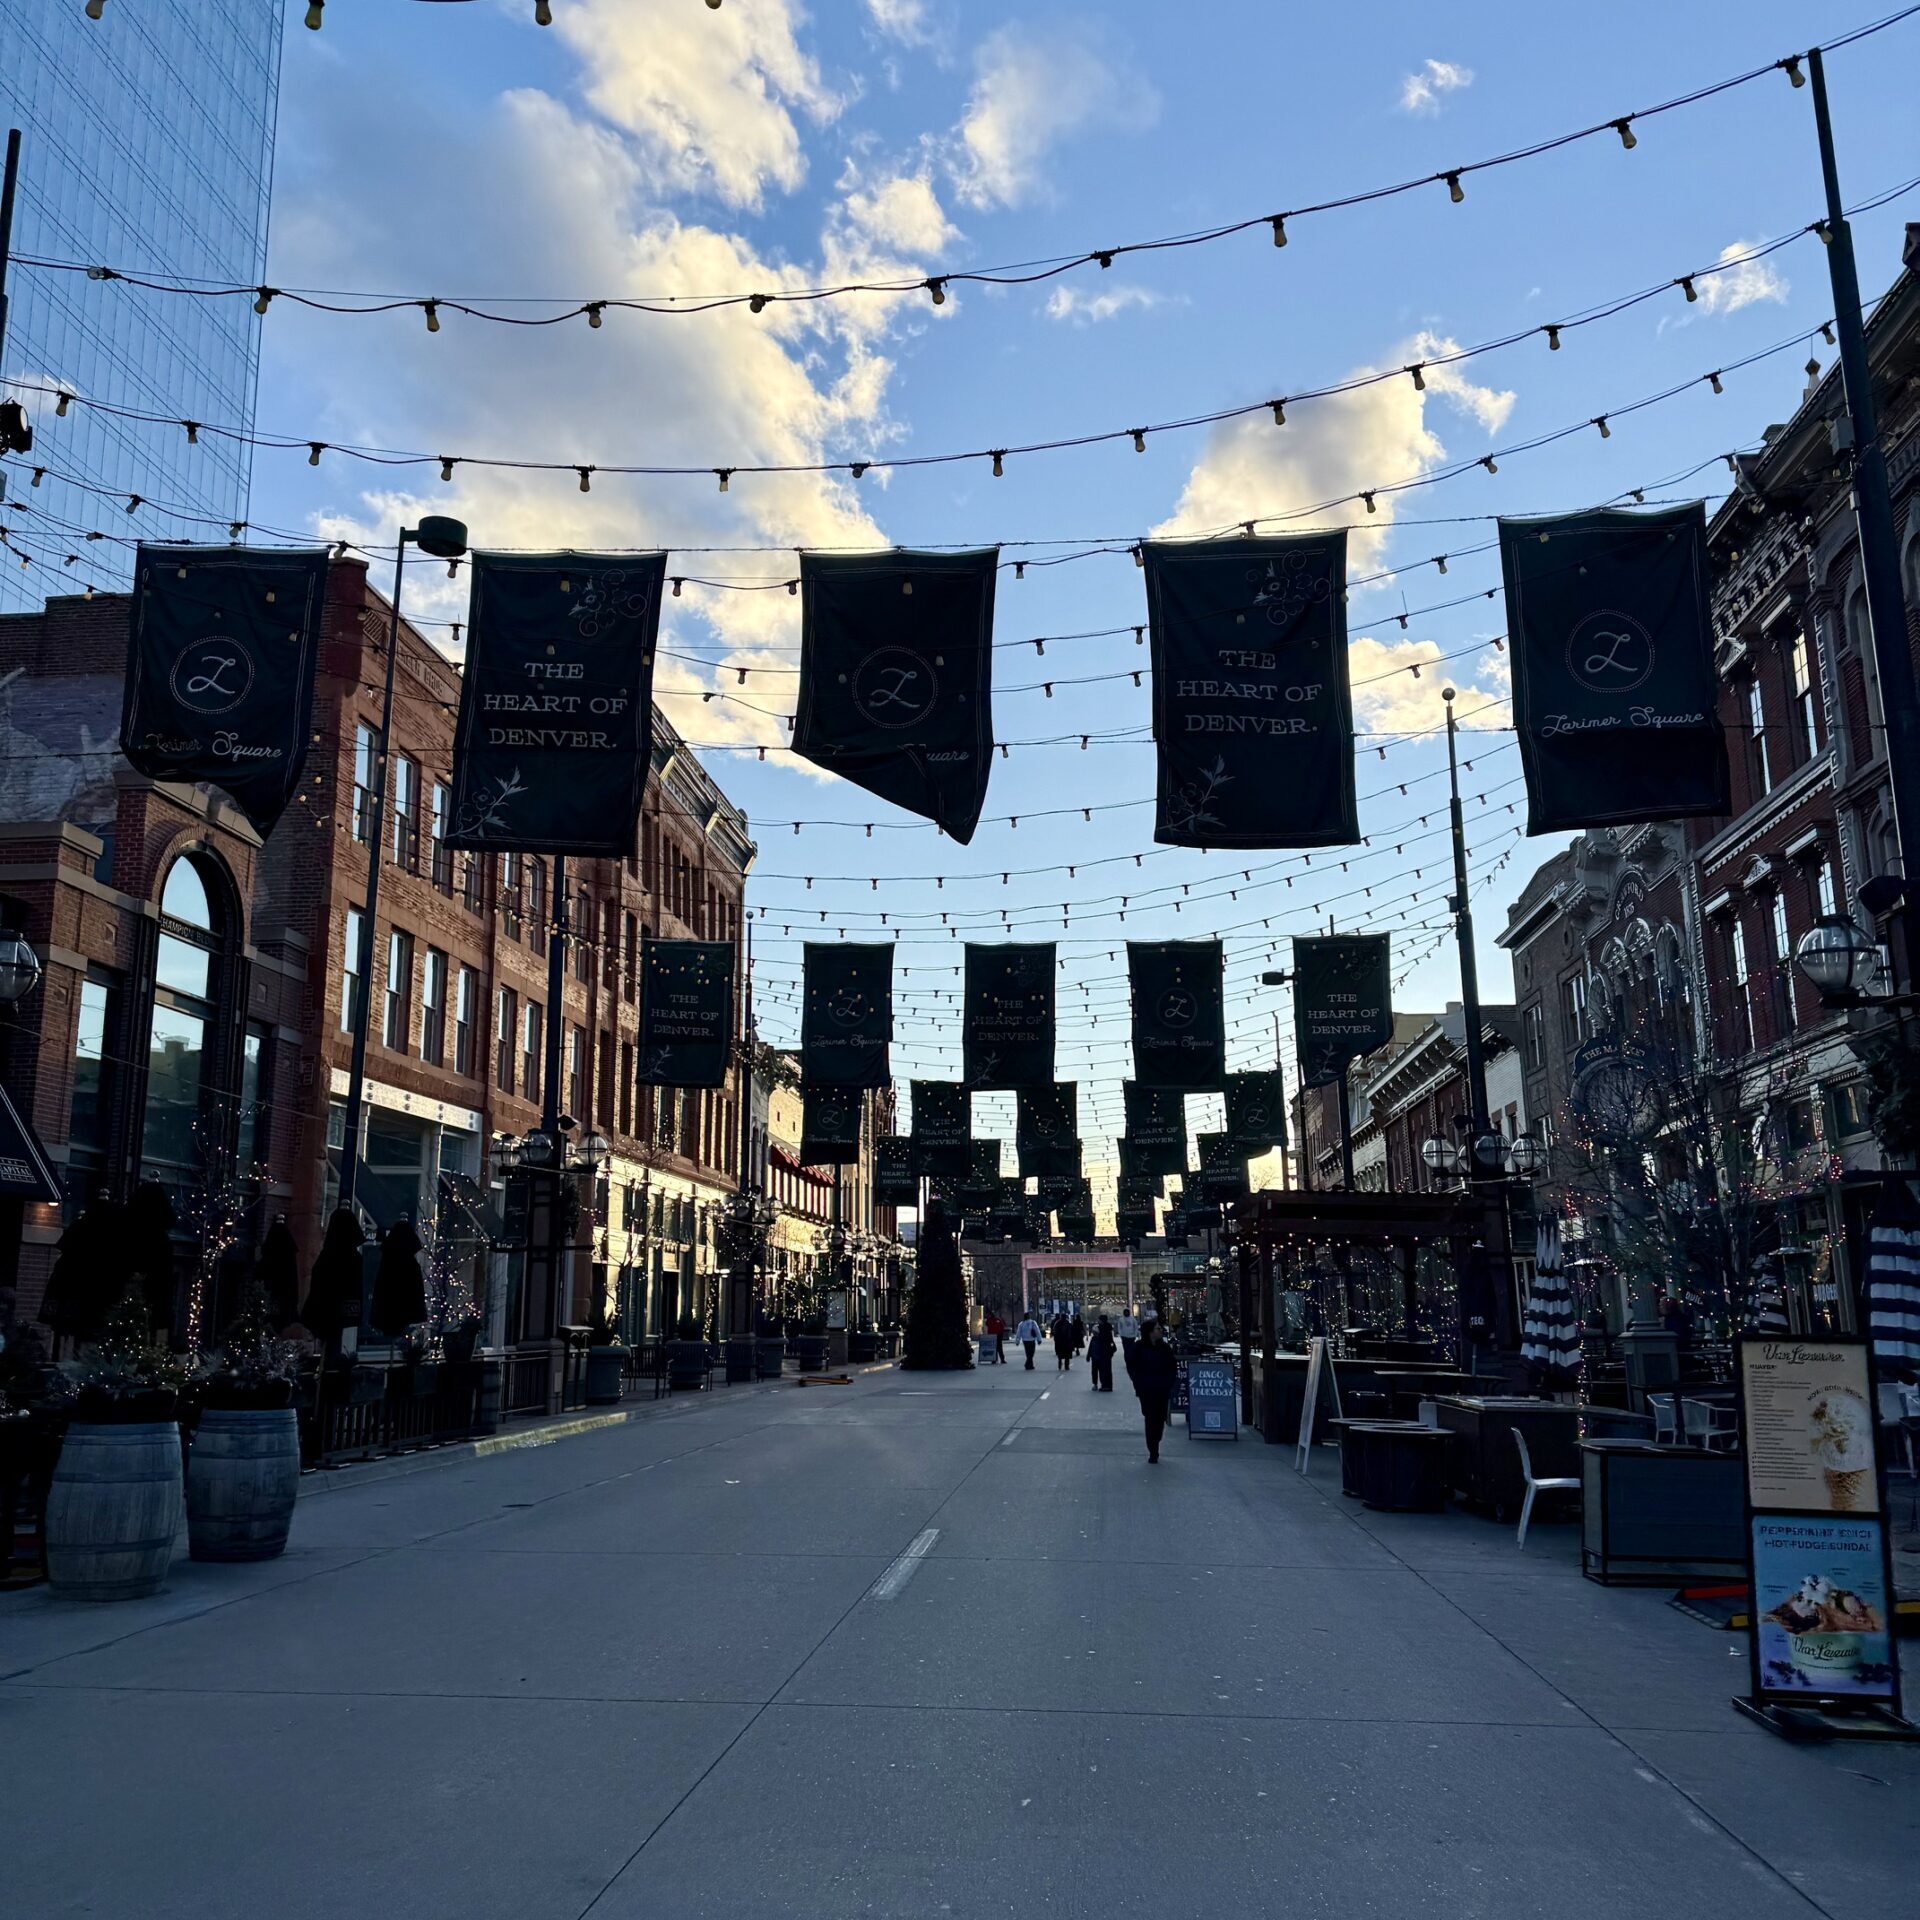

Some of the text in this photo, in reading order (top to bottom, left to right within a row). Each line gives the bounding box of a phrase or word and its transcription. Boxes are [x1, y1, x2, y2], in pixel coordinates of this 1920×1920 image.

[1219, 650, 1276, 669] THE
[524, 662, 584, 679] THE
[1176, 680, 1323, 702] HEART OF
[483, 694, 628, 715] HEART OF
[1185, 715, 1318, 734] DENVER.
[1541, 706, 1704, 738] Larimer Square
[489, 728, 617, 749] DENVER.
[212, 730, 282, 762] Square
[669, 994, 699, 1004] THE
[996, 1000, 1023, 1009] THE
[1327, 994, 1357, 1002] THE
[650, 1008, 719, 1021] HEART OF
[1307, 1008, 1380, 1019] HEART OF
[975, 1016, 1044, 1025] HEART OF
[653, 1024, 714, 1037] DENVER.
[1312, 1025, 1376, 1034] DENVER.
[978, 1032, 1039, 1041] DENVER.
[1582, 1047, 1601, 1061] THE
